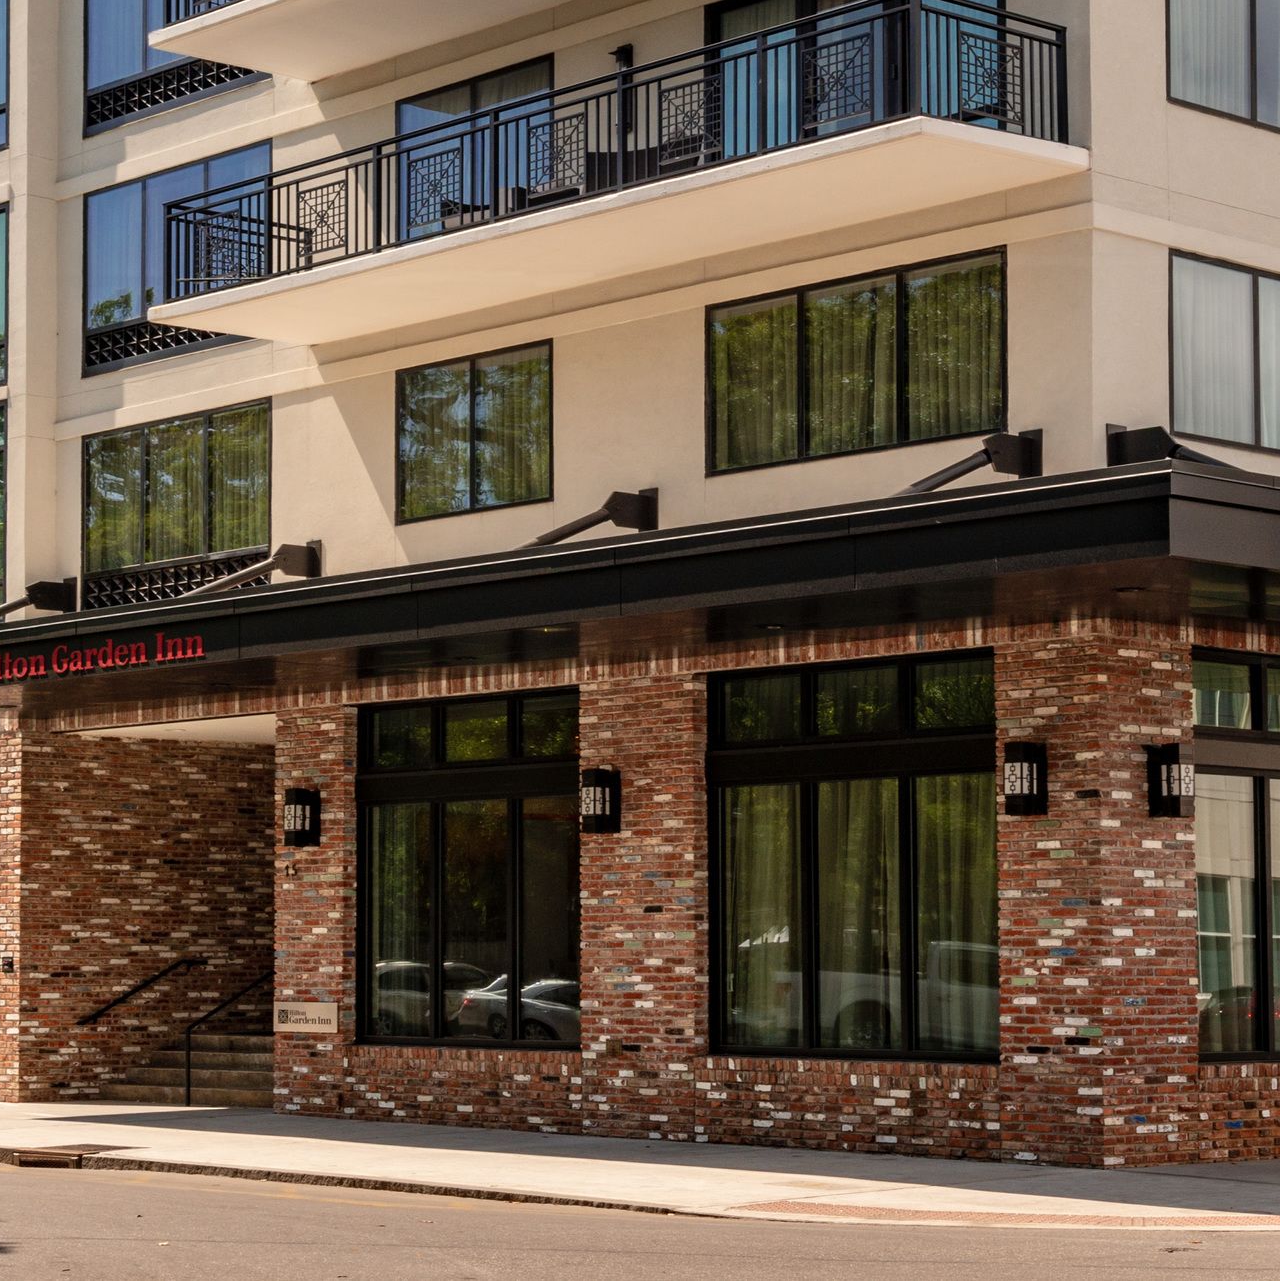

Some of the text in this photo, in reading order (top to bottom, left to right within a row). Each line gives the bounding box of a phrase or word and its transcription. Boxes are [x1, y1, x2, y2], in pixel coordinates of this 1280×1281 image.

[51, 638, 148, 673] Garden
[155, 631, 205, 662] Inn
[289, 1016, 332, 1025] Garden Inn
